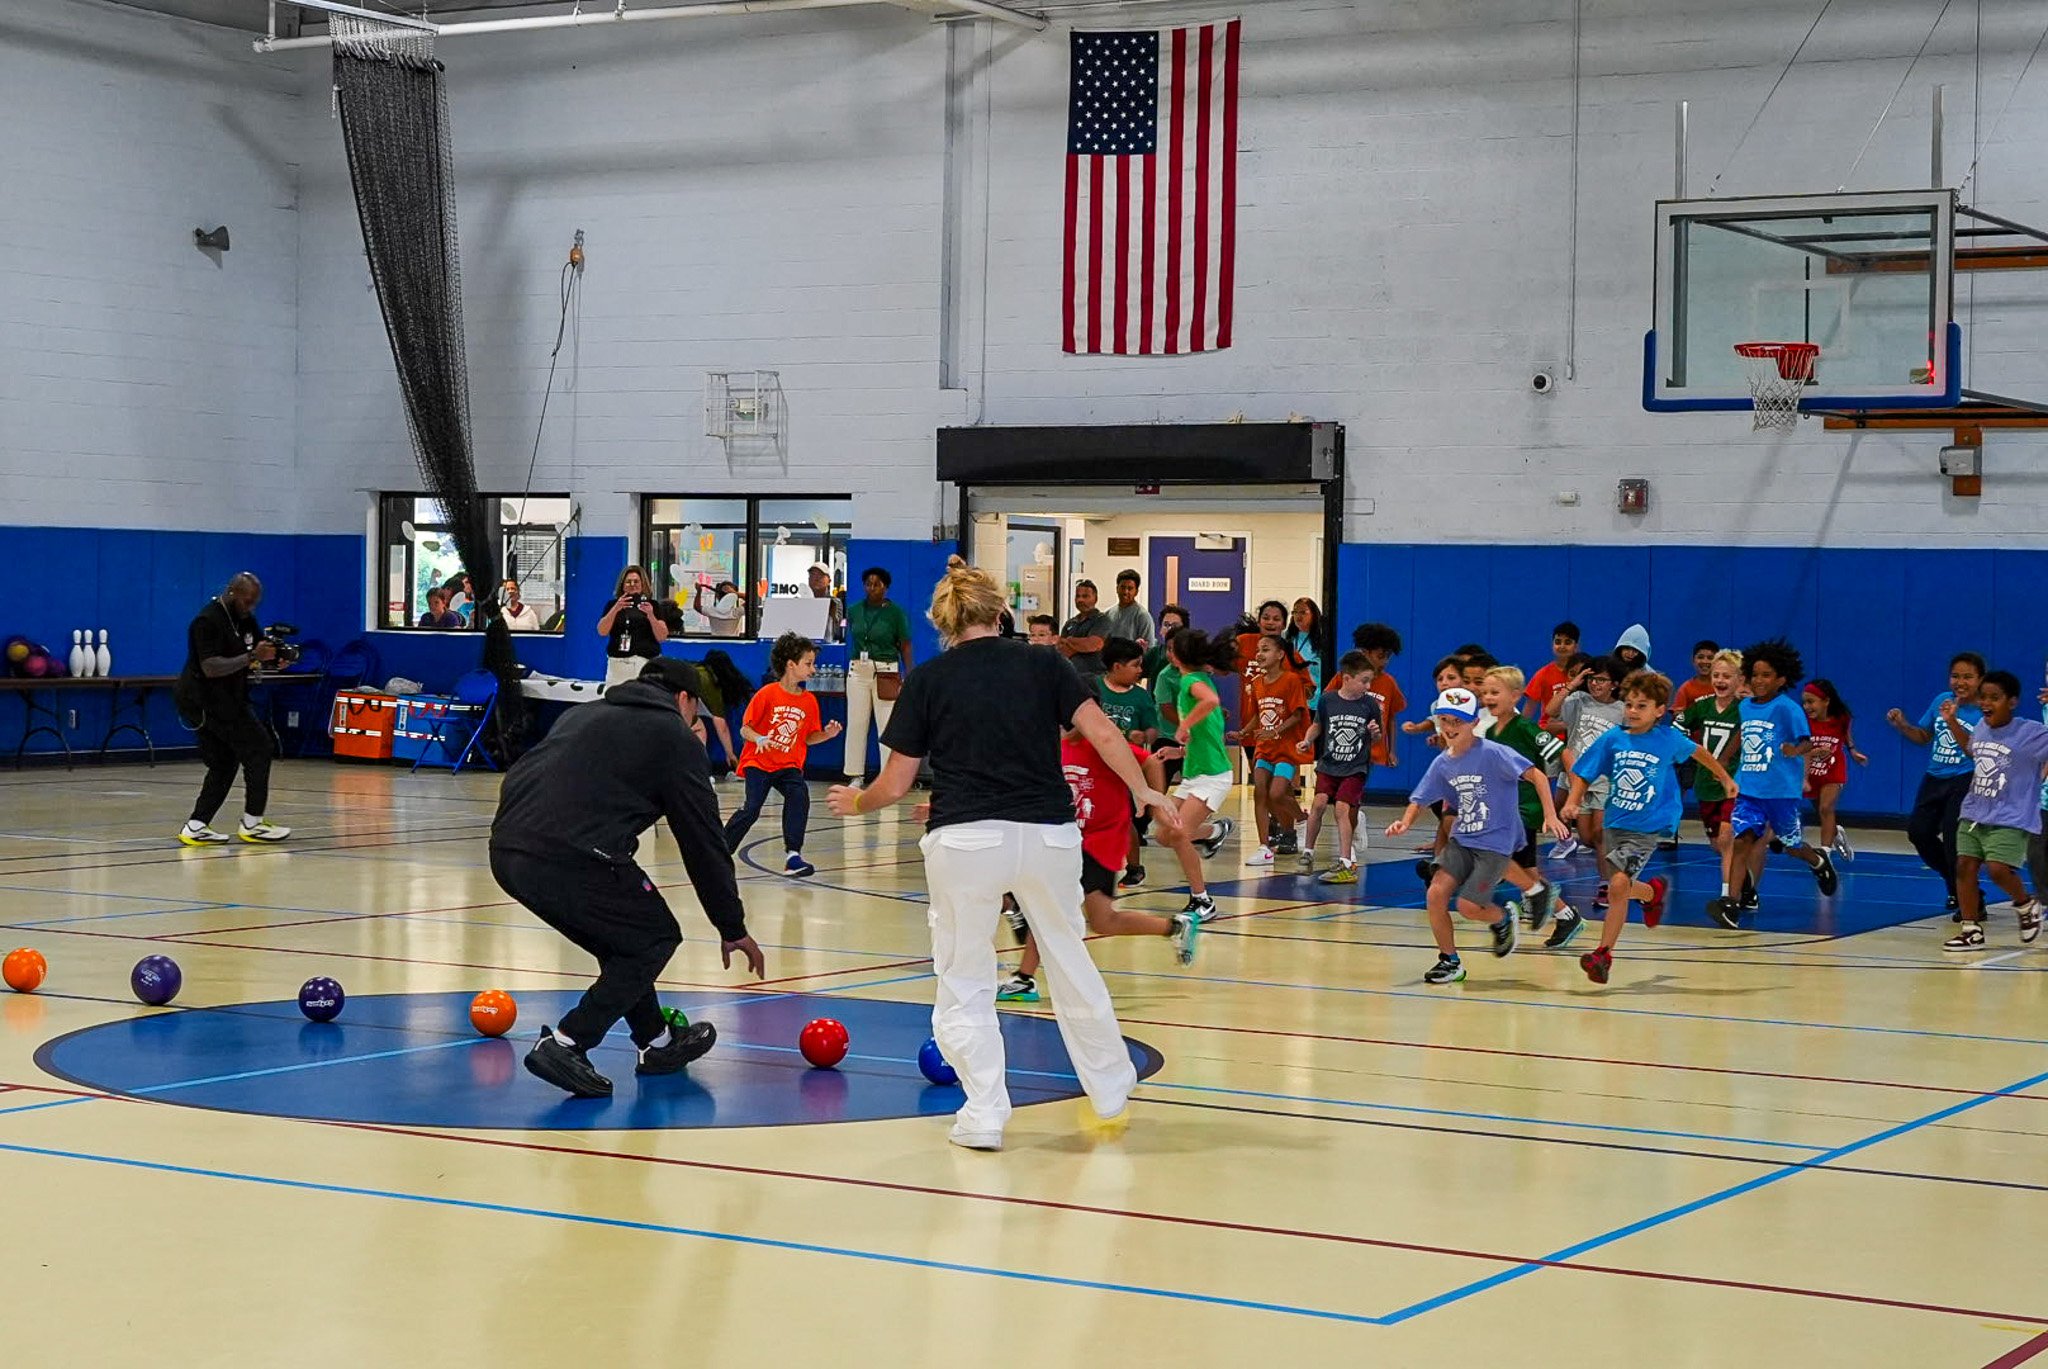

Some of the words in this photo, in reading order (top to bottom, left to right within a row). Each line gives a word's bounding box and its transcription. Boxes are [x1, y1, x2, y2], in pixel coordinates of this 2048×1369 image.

[1702, 726, 1730, 759] 17
[1937, 746, 1957, 755] CAMP
[1628, 750, 1646, 759] GIRLS
[1645, 753, 1660, 764] CLUB
[1976, 777, 1993, 786] AMP
[1617, 789, 1641, 800] CAMP
[1612, 796, 1644, 810] CLIFTON
